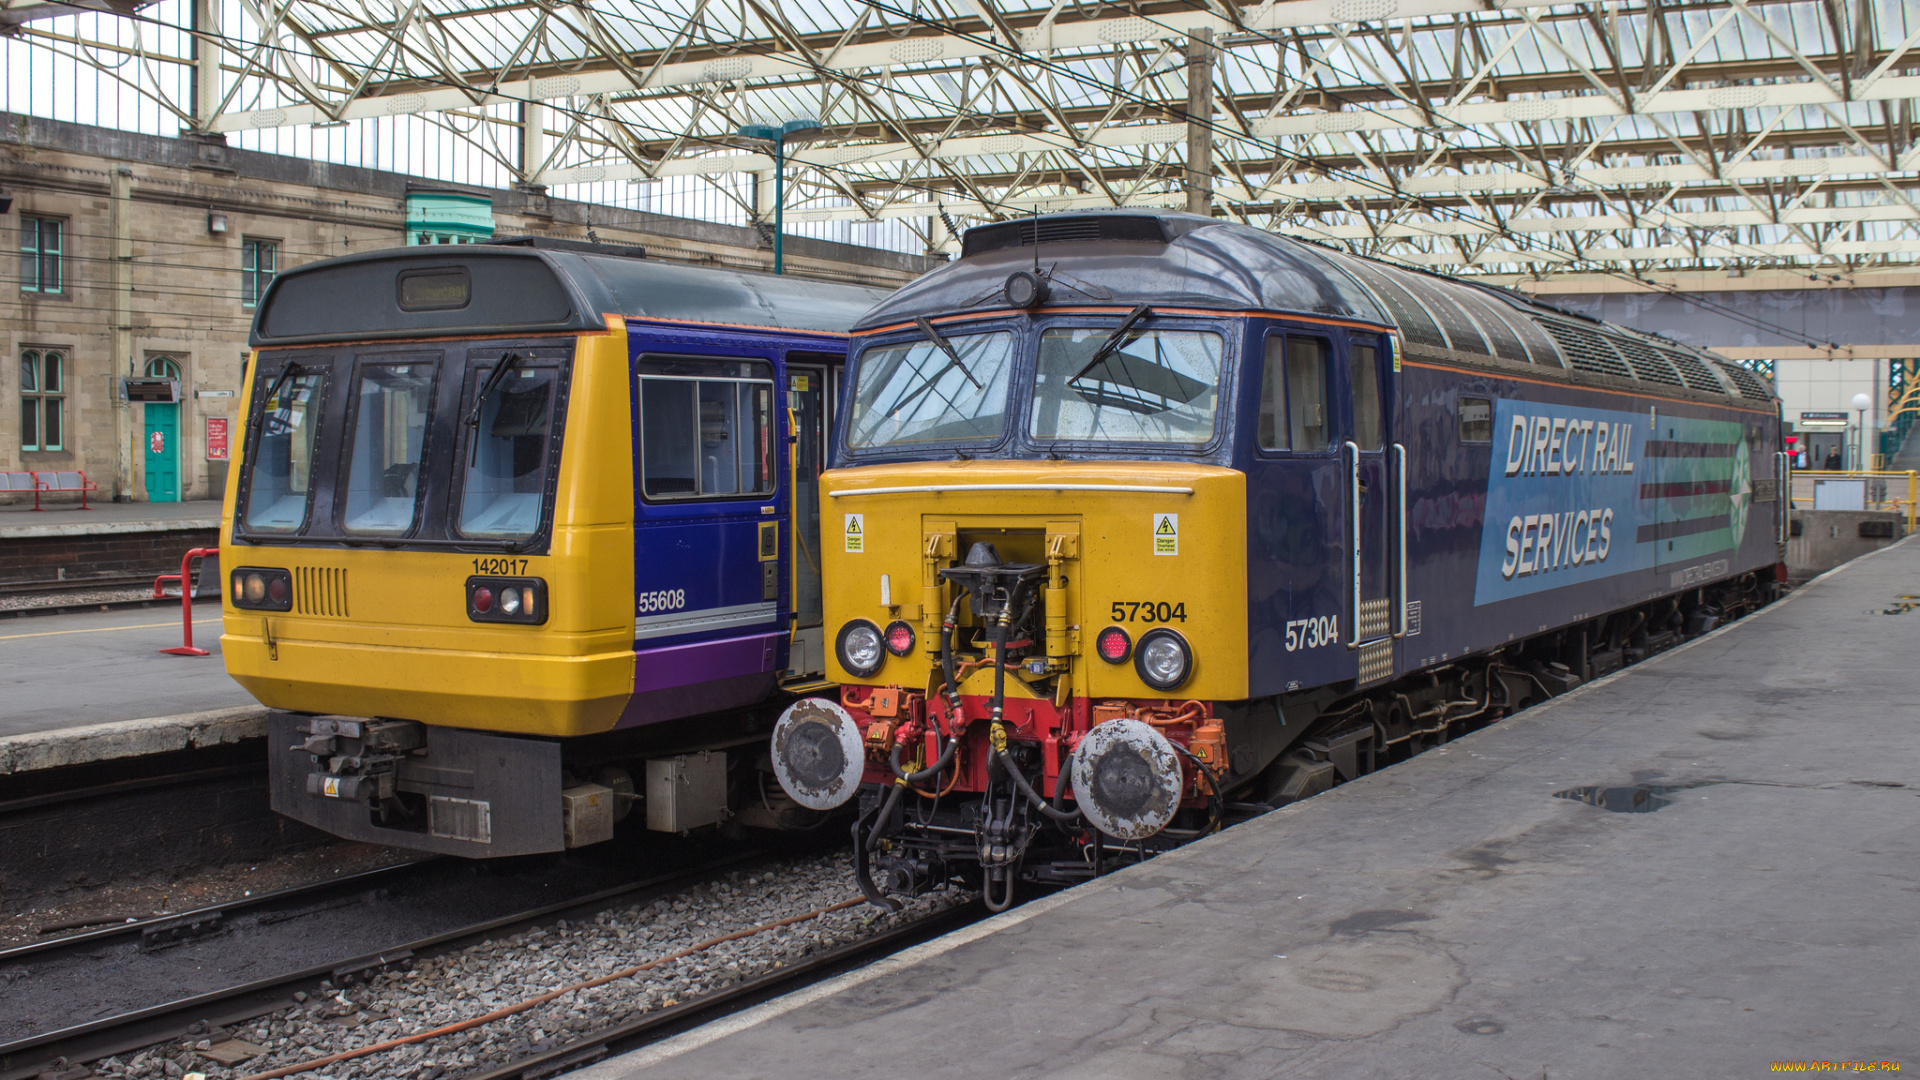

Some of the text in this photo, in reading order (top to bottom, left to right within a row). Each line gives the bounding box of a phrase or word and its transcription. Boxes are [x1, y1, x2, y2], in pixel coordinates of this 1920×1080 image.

[1505, 415, 1634, 477] DIRECT RAIL
[1501, 507, 1614, 581] SERVICES
[472, 558, 528, 576] 142017
[638, 588, 685, 613] 55608
[1111, 601, 1188, 623] 57304
[1284, 614, 1339, 652] 57304
